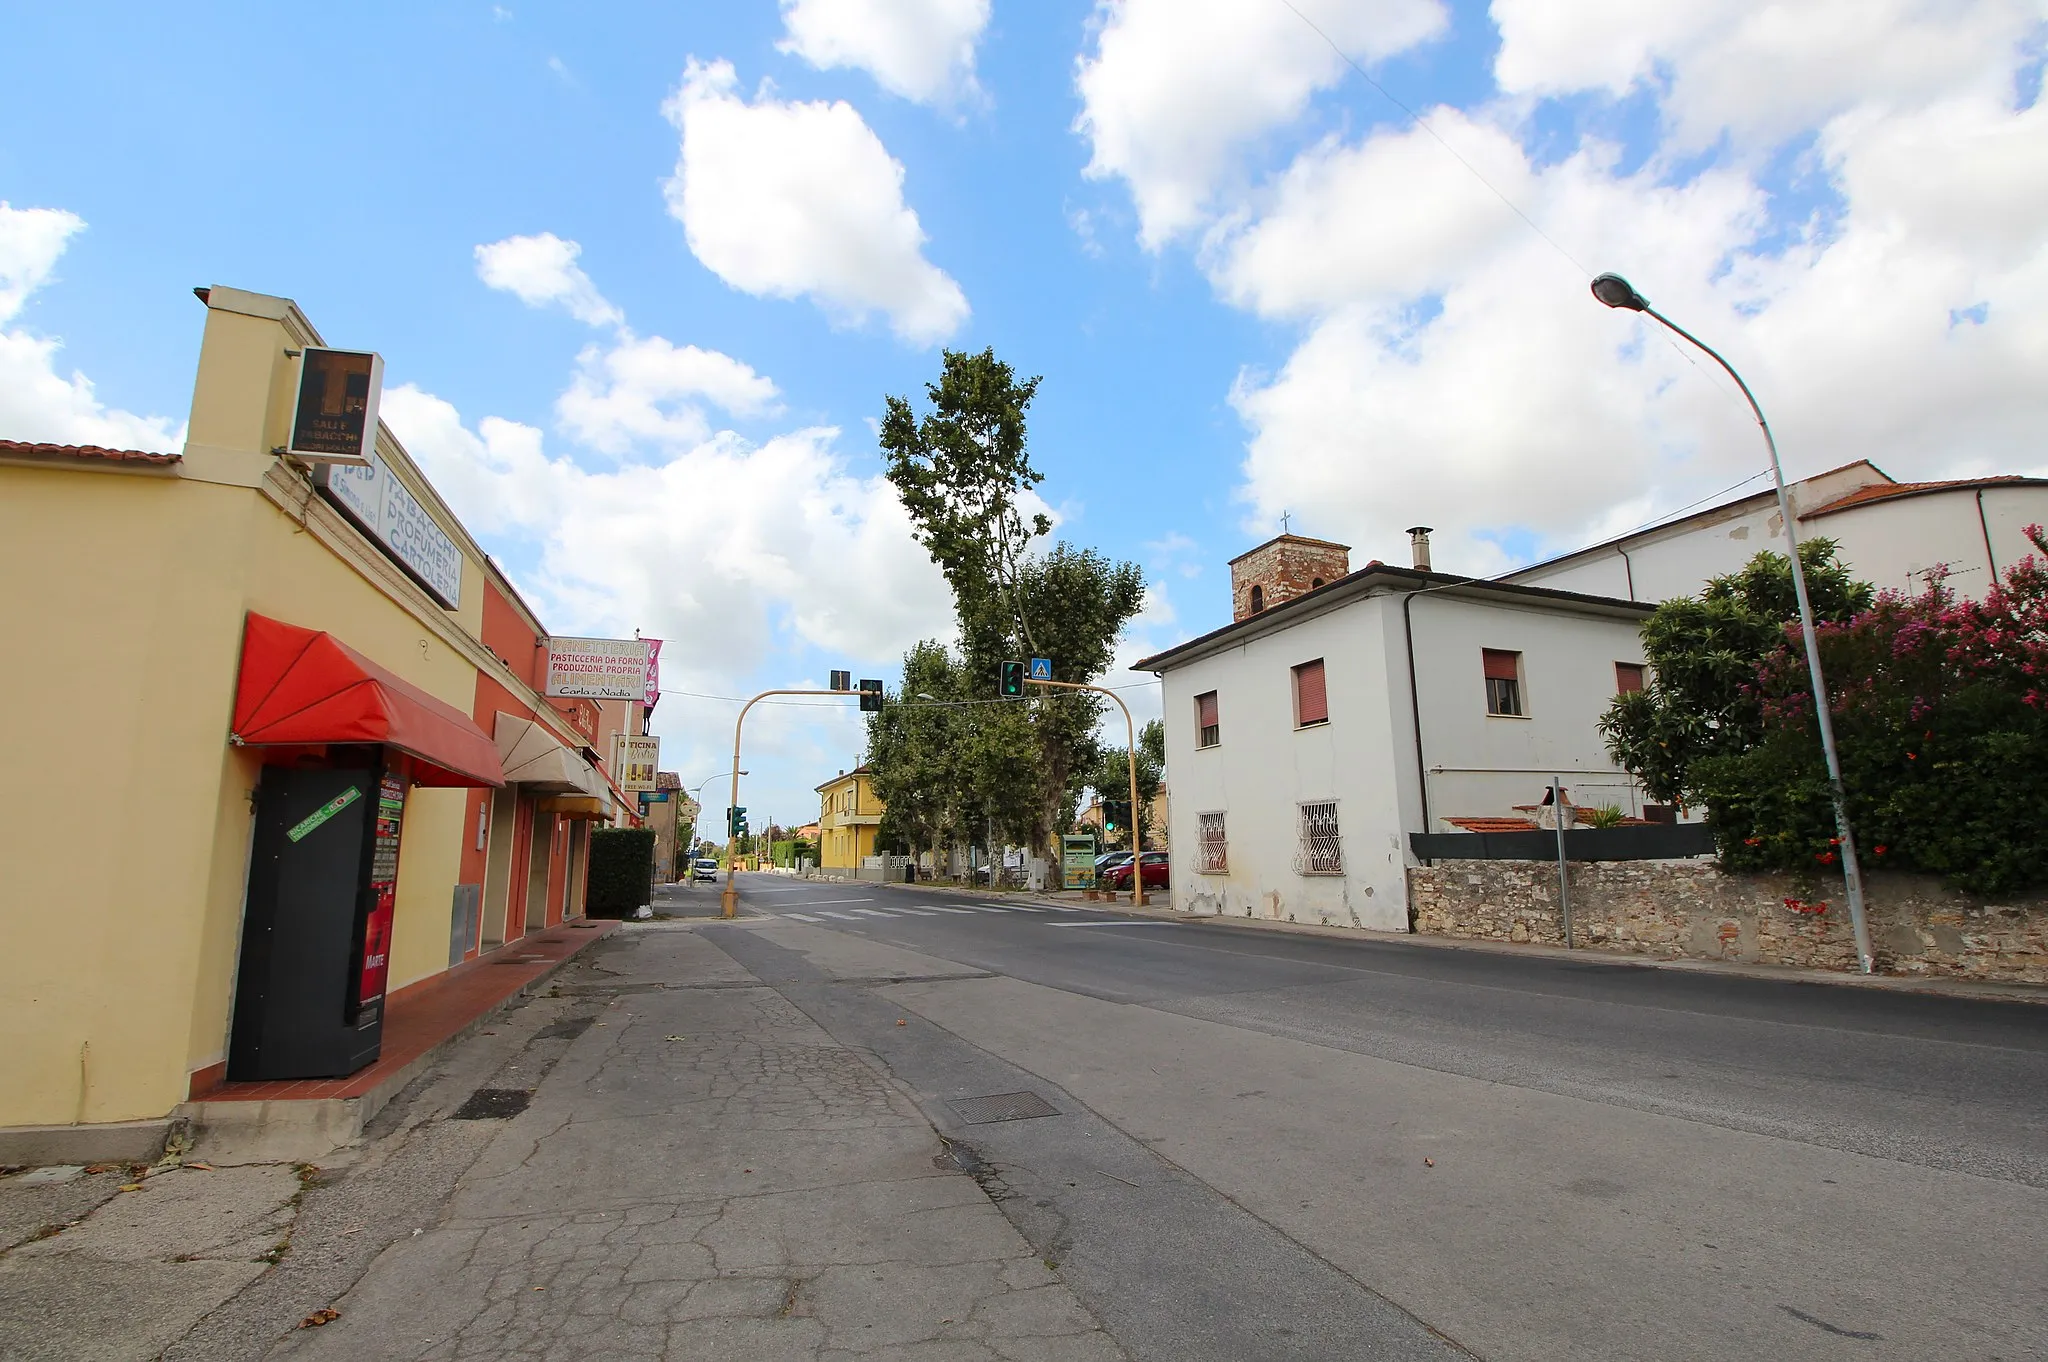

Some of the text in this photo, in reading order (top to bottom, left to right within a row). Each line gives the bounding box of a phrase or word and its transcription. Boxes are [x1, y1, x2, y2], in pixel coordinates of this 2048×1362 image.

[387, 473, 456, 562] TABACCHI
[387, 500, 457, 582] PROFUMERIA
[390, 528, 457, 604] CARTOLERIA
[552, 639, 645, 656] PANETTERIA
[551, 653, 644, 666] PASTICCERIA DA FORNO
[552, 663, 641, 674] PRODUZIONE PROPRIA
[551, 672, 641, 688] ALIMENTARI
[560, 687, 590, 695] Carla
[599, 688, 631, 697] Nadia
[620, 741, 657, 750] OFICINA
[289, 810, 323, 836] RICARICHE
[365, 953, 385, 969] MARTE
